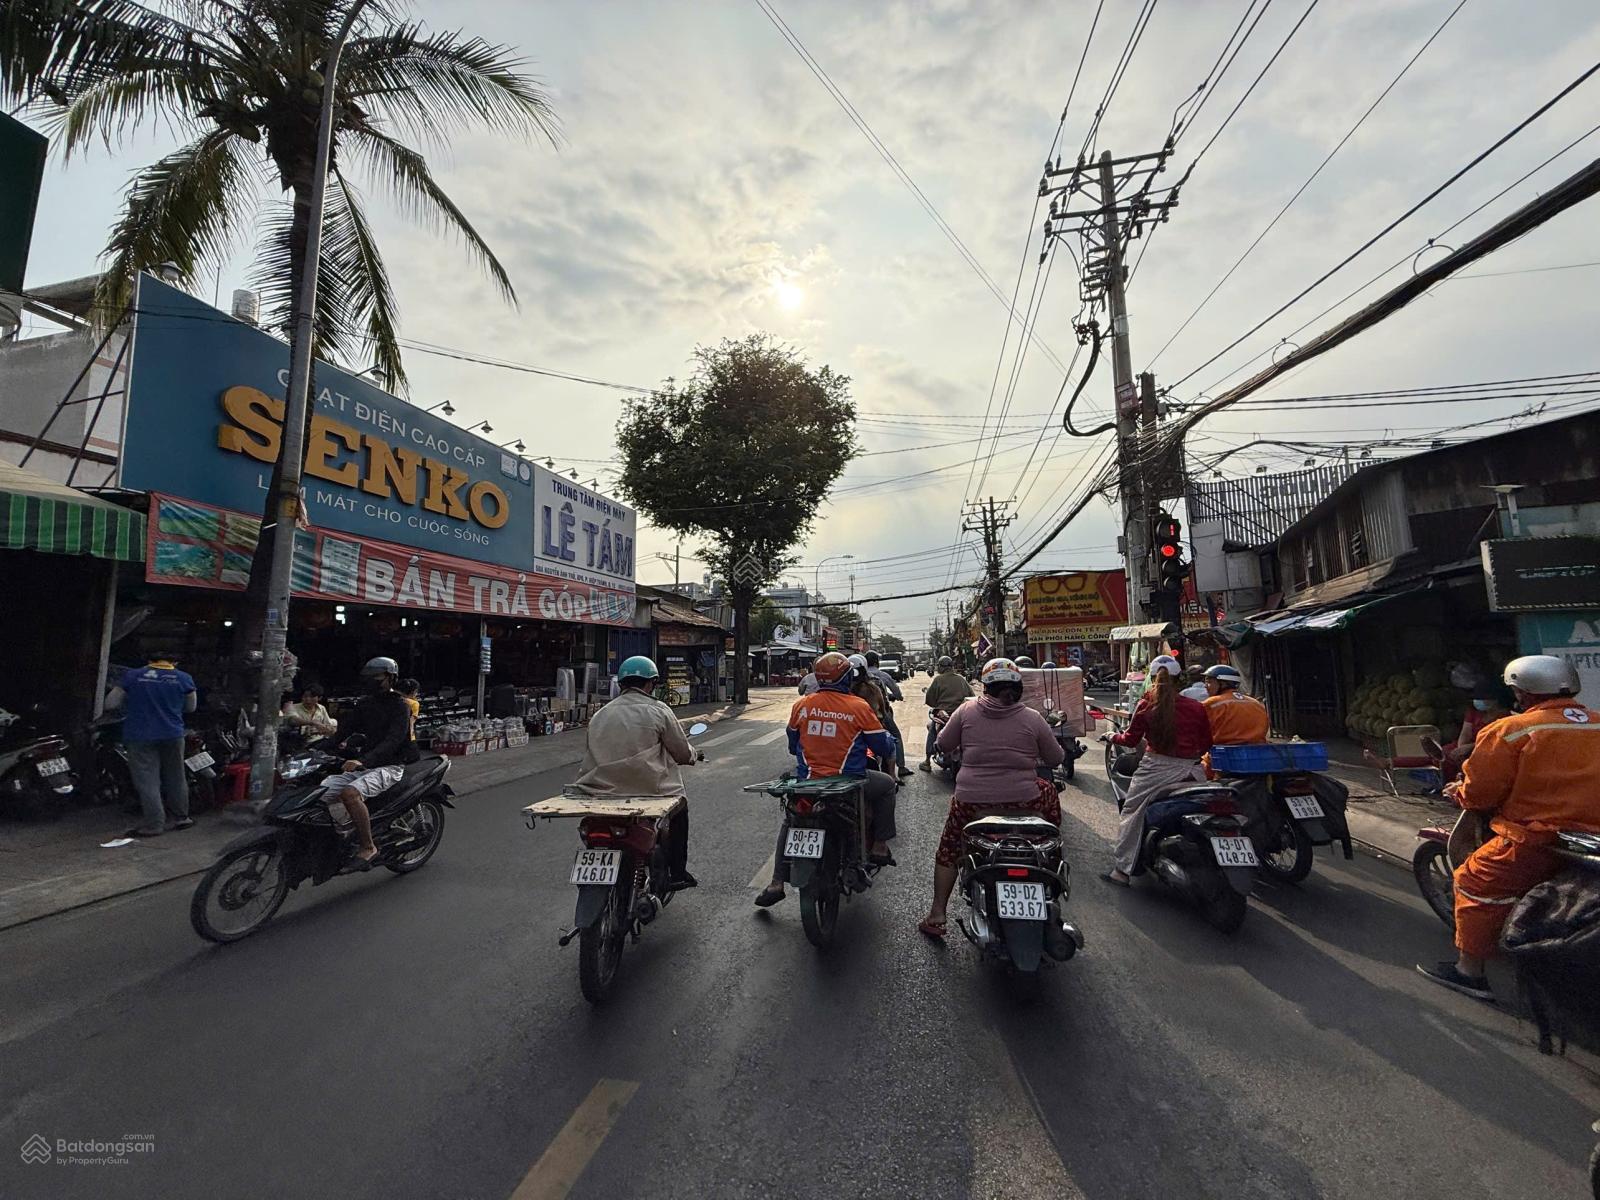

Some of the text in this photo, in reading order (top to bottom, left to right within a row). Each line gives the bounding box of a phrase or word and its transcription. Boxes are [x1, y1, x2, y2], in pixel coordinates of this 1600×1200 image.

[355, 402, 406, 437] ĐIỆN
[411, 428, 449, 454] CAO
[453, 448, 485, 468] CẤP
[217, 385, 510, 529] SENKO
[551, 479, 578, 502] TRUNG
[580, 490, 595, 508] TÂM
[596, 499, 611, 516] ĐIỆN
[364, 504, 402, 523] CHO
[454, 527, 489, 546] SỐNG
[542, 501, 633, 577] LÊ TÁM
[365, 554, 457, 609] BÁN
[468, 571, 531, 616] TRẢ
[538, 584, 588, 621] GÓP
[786, 842, 820, 856] 294.91
[793, 830, 819, 843] 60-F3
[581, 852, 614, 866] 59-KA
[576, 867, 614, 882] 146.01
[1003, 884, 1038, 900] 59-D2
[1000, 900, 1043, 918] 533.67
